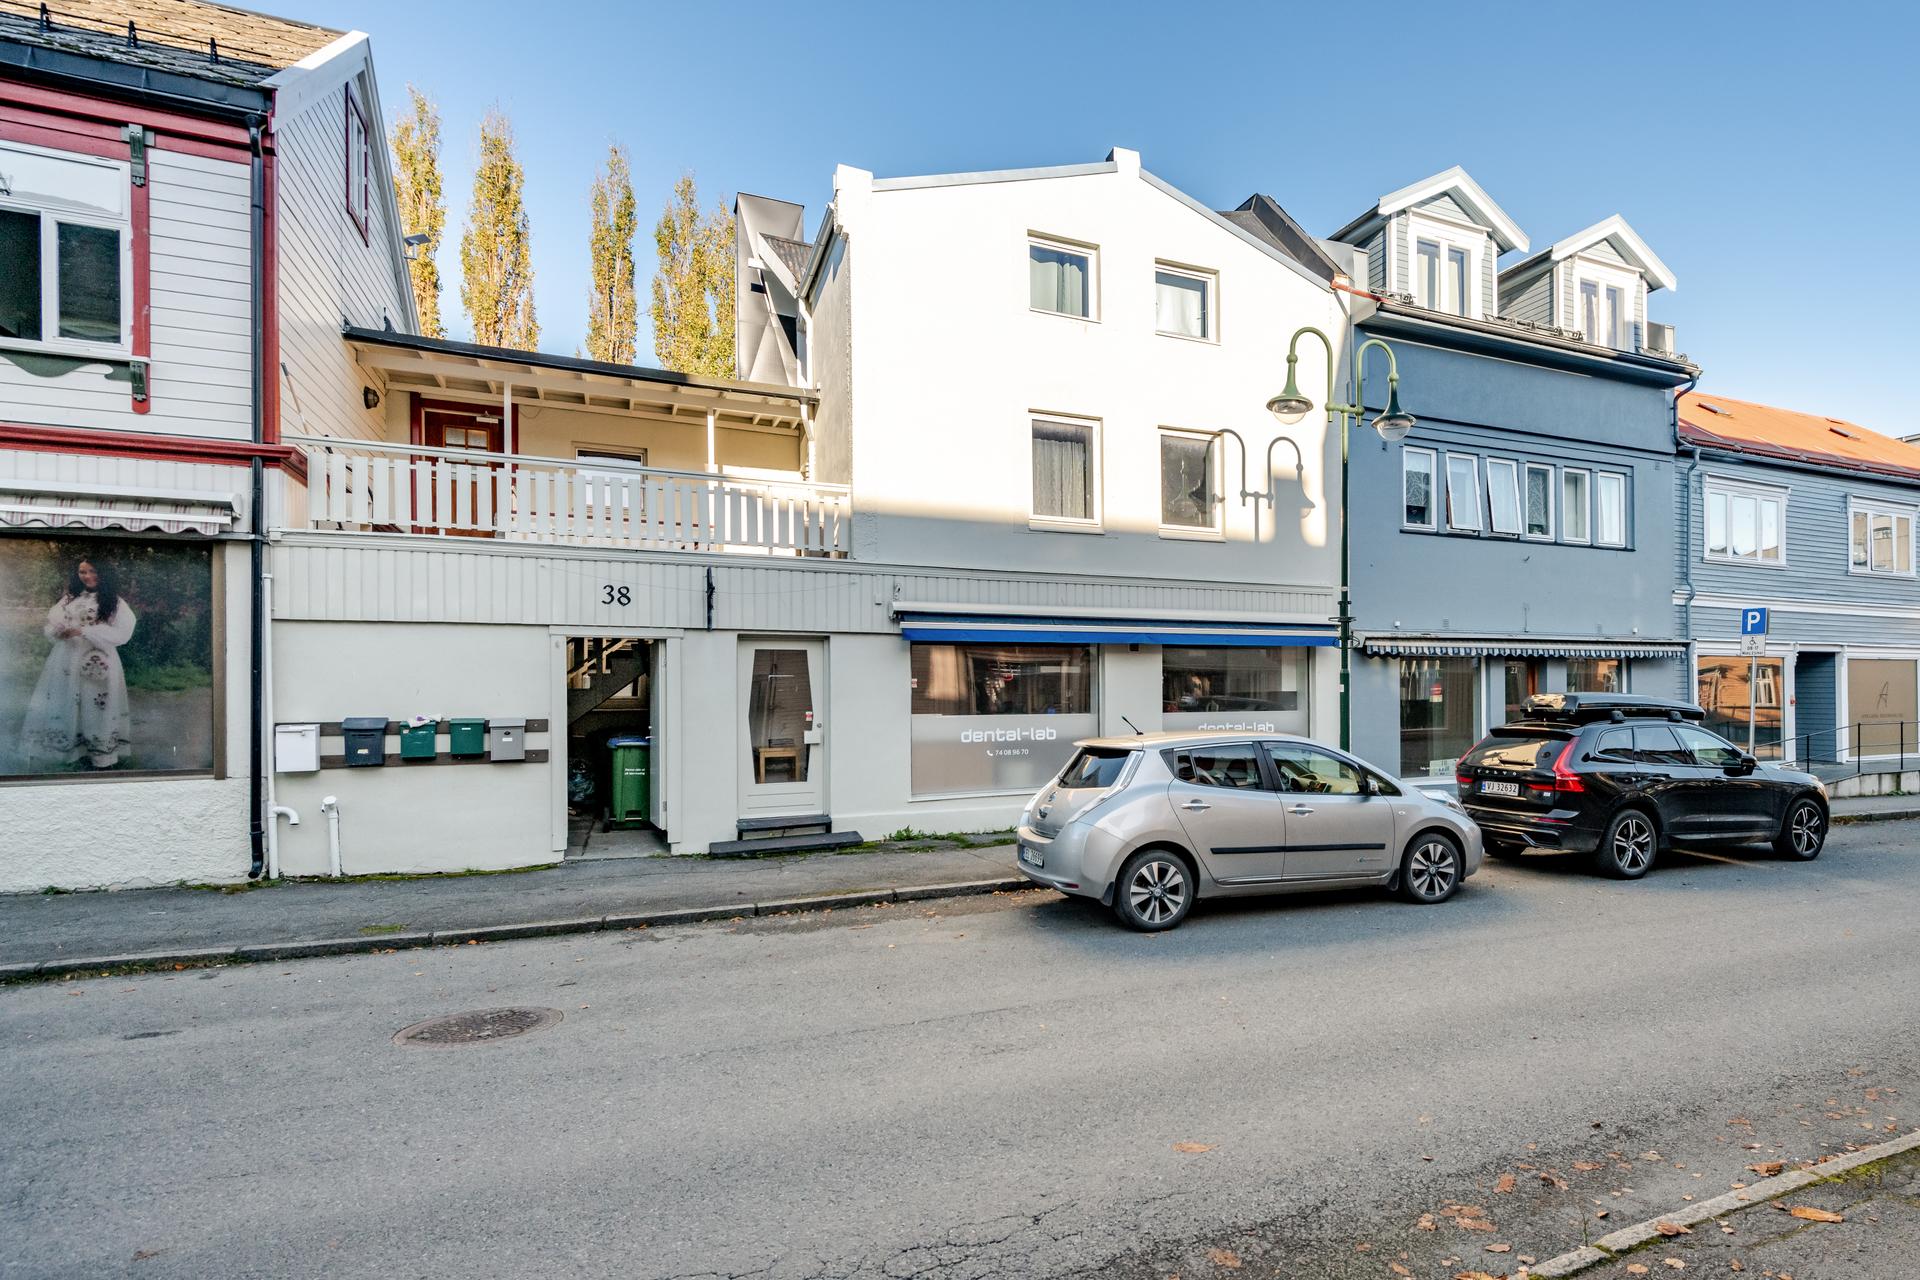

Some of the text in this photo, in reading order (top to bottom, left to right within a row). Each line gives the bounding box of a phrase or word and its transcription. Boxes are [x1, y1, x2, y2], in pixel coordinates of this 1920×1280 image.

[601, 584, 632, 607] 38
[1747, 611, 1761, 631] P
[960, 726, 1057, 743] dental-lab
[1487, 782, 1517, 793] VJ 32632
